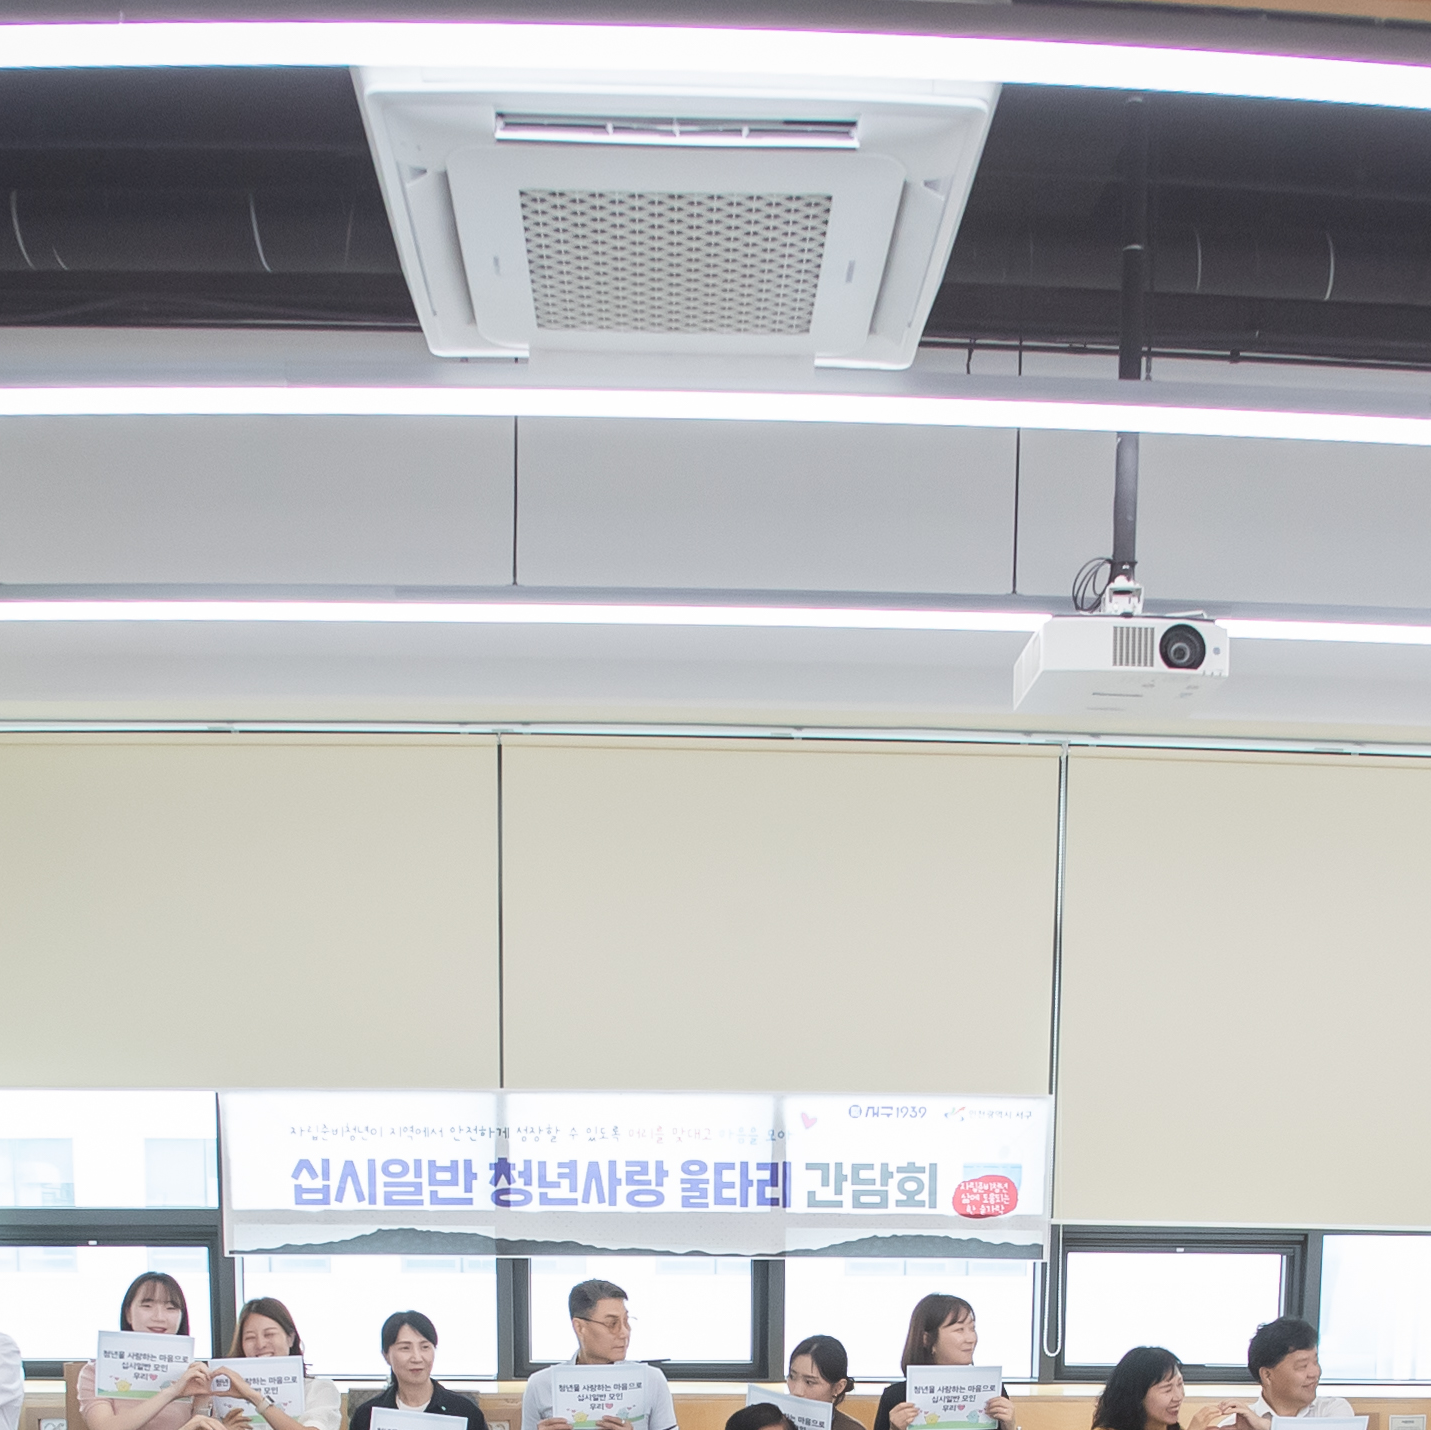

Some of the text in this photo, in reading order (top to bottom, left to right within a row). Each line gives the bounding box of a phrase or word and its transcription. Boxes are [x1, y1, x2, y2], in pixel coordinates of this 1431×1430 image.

[290, 1123, 383, 1142] 자립준비청년이
[389, 1123, 443, 1142] 지역에서
[449, 1124, 510, 1142] 안전하게
[516, 1124, 561, 1143] 성장할
[569, 1124, 579, 1141] 수
[586, 1125, 621, 1143] 있도록
[672, 1127, 712, 1147] 맞대고
[291, 1157, 938, 1210] 십시일반 청년사랑 울타리 간담회
[104, 1350, 189, 1363] 청년을 사랑하는 마음으로
[122, 1362, 168, 1372] 십시일반 모인
[134, 1372, 149, 1380] 우리
[559, 1382, 642, 1392] 청년을 사랑하는 마음으로
[578, 1393, 606, 1401] 십시일반
